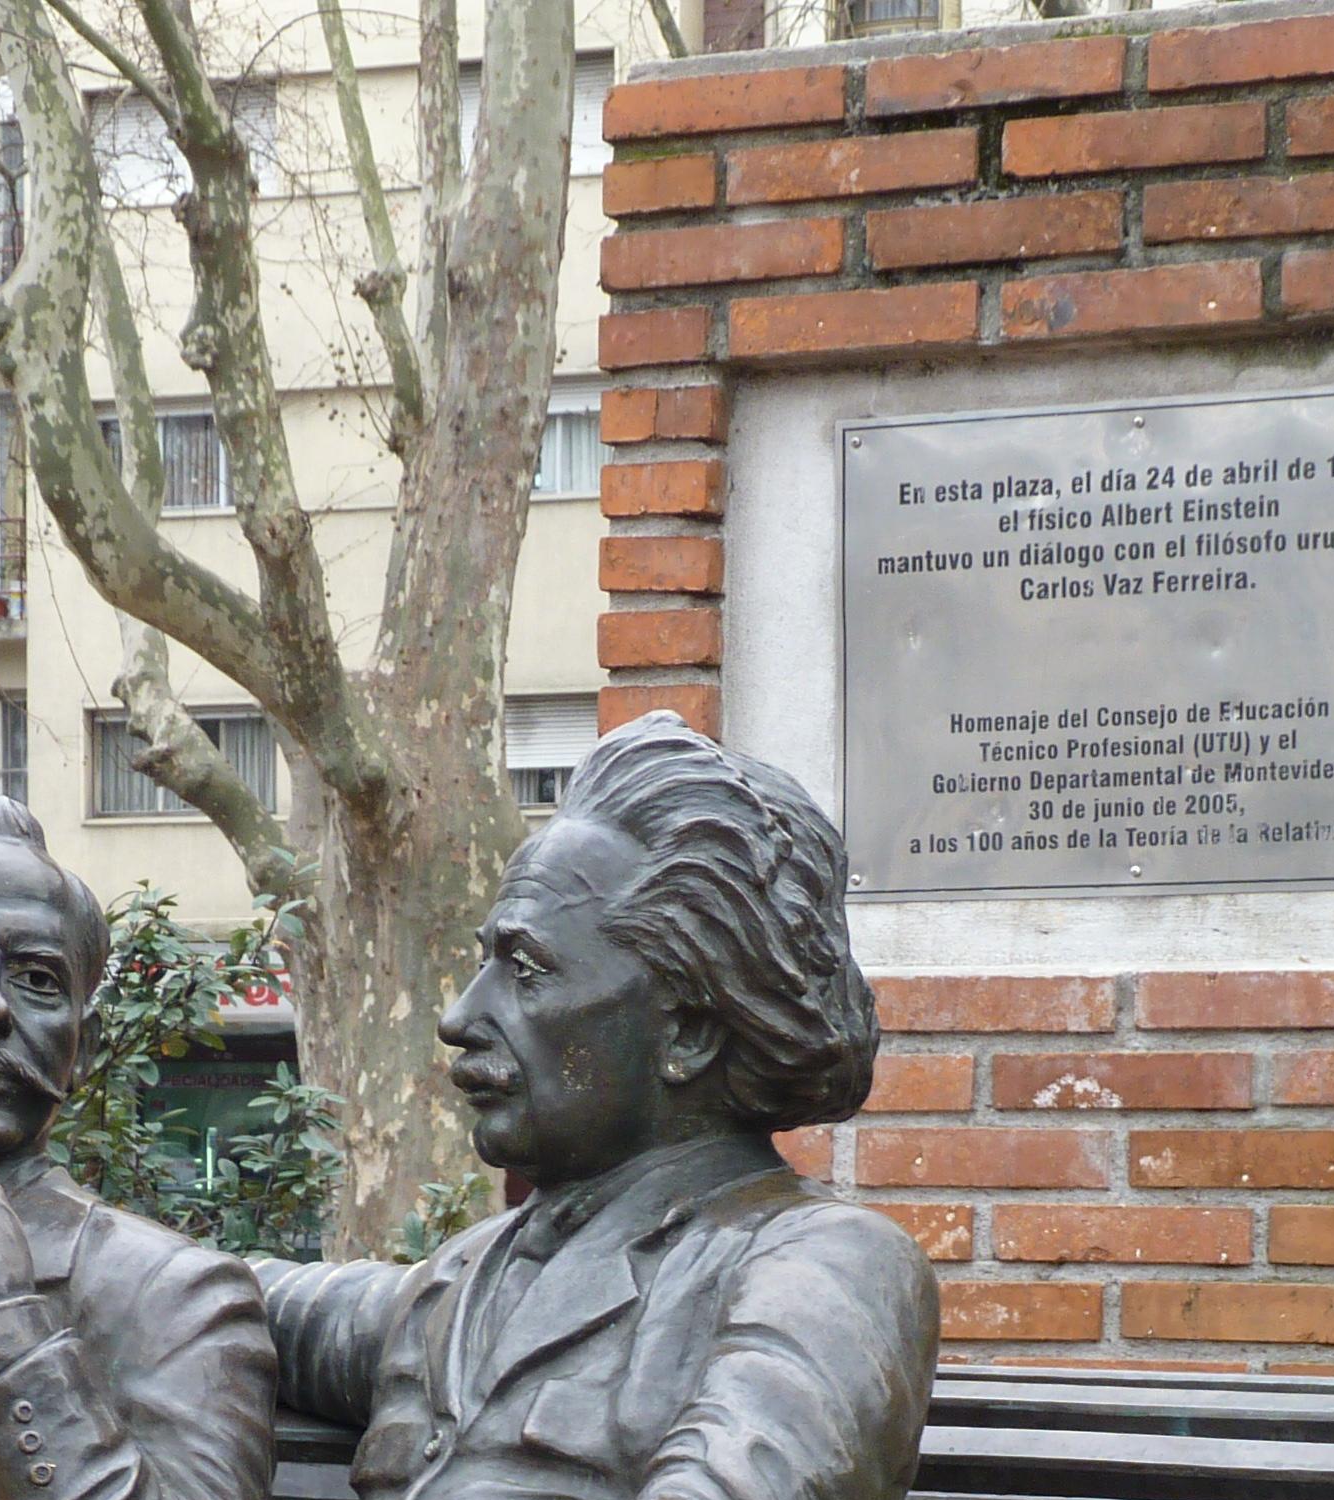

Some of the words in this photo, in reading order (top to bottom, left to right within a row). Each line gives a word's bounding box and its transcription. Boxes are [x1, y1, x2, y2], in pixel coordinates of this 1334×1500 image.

[899, 482, 925, 505] En
[935, 479, 983, 503] esta
[993, 475, 1061, 504] plaza,
[1071, 471, 1091, 494] el
[1101, 469, 1136, 493] día
[1146, 466, 1175, 491] 24
[1185, 464, 1213, 488] de
[1222, 459, 1278, 485] abril
[1287, 457, 1316, 481] de
[999, 510, 1018, 533] el
[1028, 507, 1092, 531] físico
[1101, 501, 1173, 527] Albert
[1183, 495, 1279, 523] Einstein
[878, 550, 973, 575] mantuvo
[983, 550, 1010, 568] un
[1019, 542, 1104, 568] diálogo
[1115, 541, 1155, 561] con
[1165, 535, 1185, 558] el
[1195, 529, 1287, 557] filósofo
[1020, 577, 1094, 601] Carlos
[1103, 573, 1143, 597] Vaz
[1152, 567, 1256, 594] Ferreira.
[950, 710, 1049, 735] Homenaje
[1058, 708, 1088, 729] del
[1097, 704, 1177, 729] Consejo
[1186, 703, 1210, 723] de
[1219, 696, 1329, 722] Educación
[979, 741, 1058, 763] Técnico
[1067, 734, 1184, 759] Profesional
[1193, 731, 1250, 758] (UTU)
[1260, 734, 1270, 753] y
[1278, 730, 1297, 750] el
[933, 773, 1021, 794] Gobierno
[1030, 765, 1183, 794] Departamental
[1191, 763, 1215, 784] de
[1028, 800, 1054, 821] 30
[1062, 799, 1085, 819] de
[1093, 797, 1144, 822] junio
[1153, 797, 1176, 816] de
[1184, 794, 1245, 817] 2005,
[910, 838, 921, 854] a
[929, 834, 958, 853] los
[966, 832, 1003, 852] 100
[1011, 831, 1059, 850] años
[1067, 829, 1090, 849] de
[1099, 828, 1117, 848] la
[1125, 826, 1188, 847] Teoría
[1197, 825, 1221, 845] de
[1229, 823, 1248, 843] la
